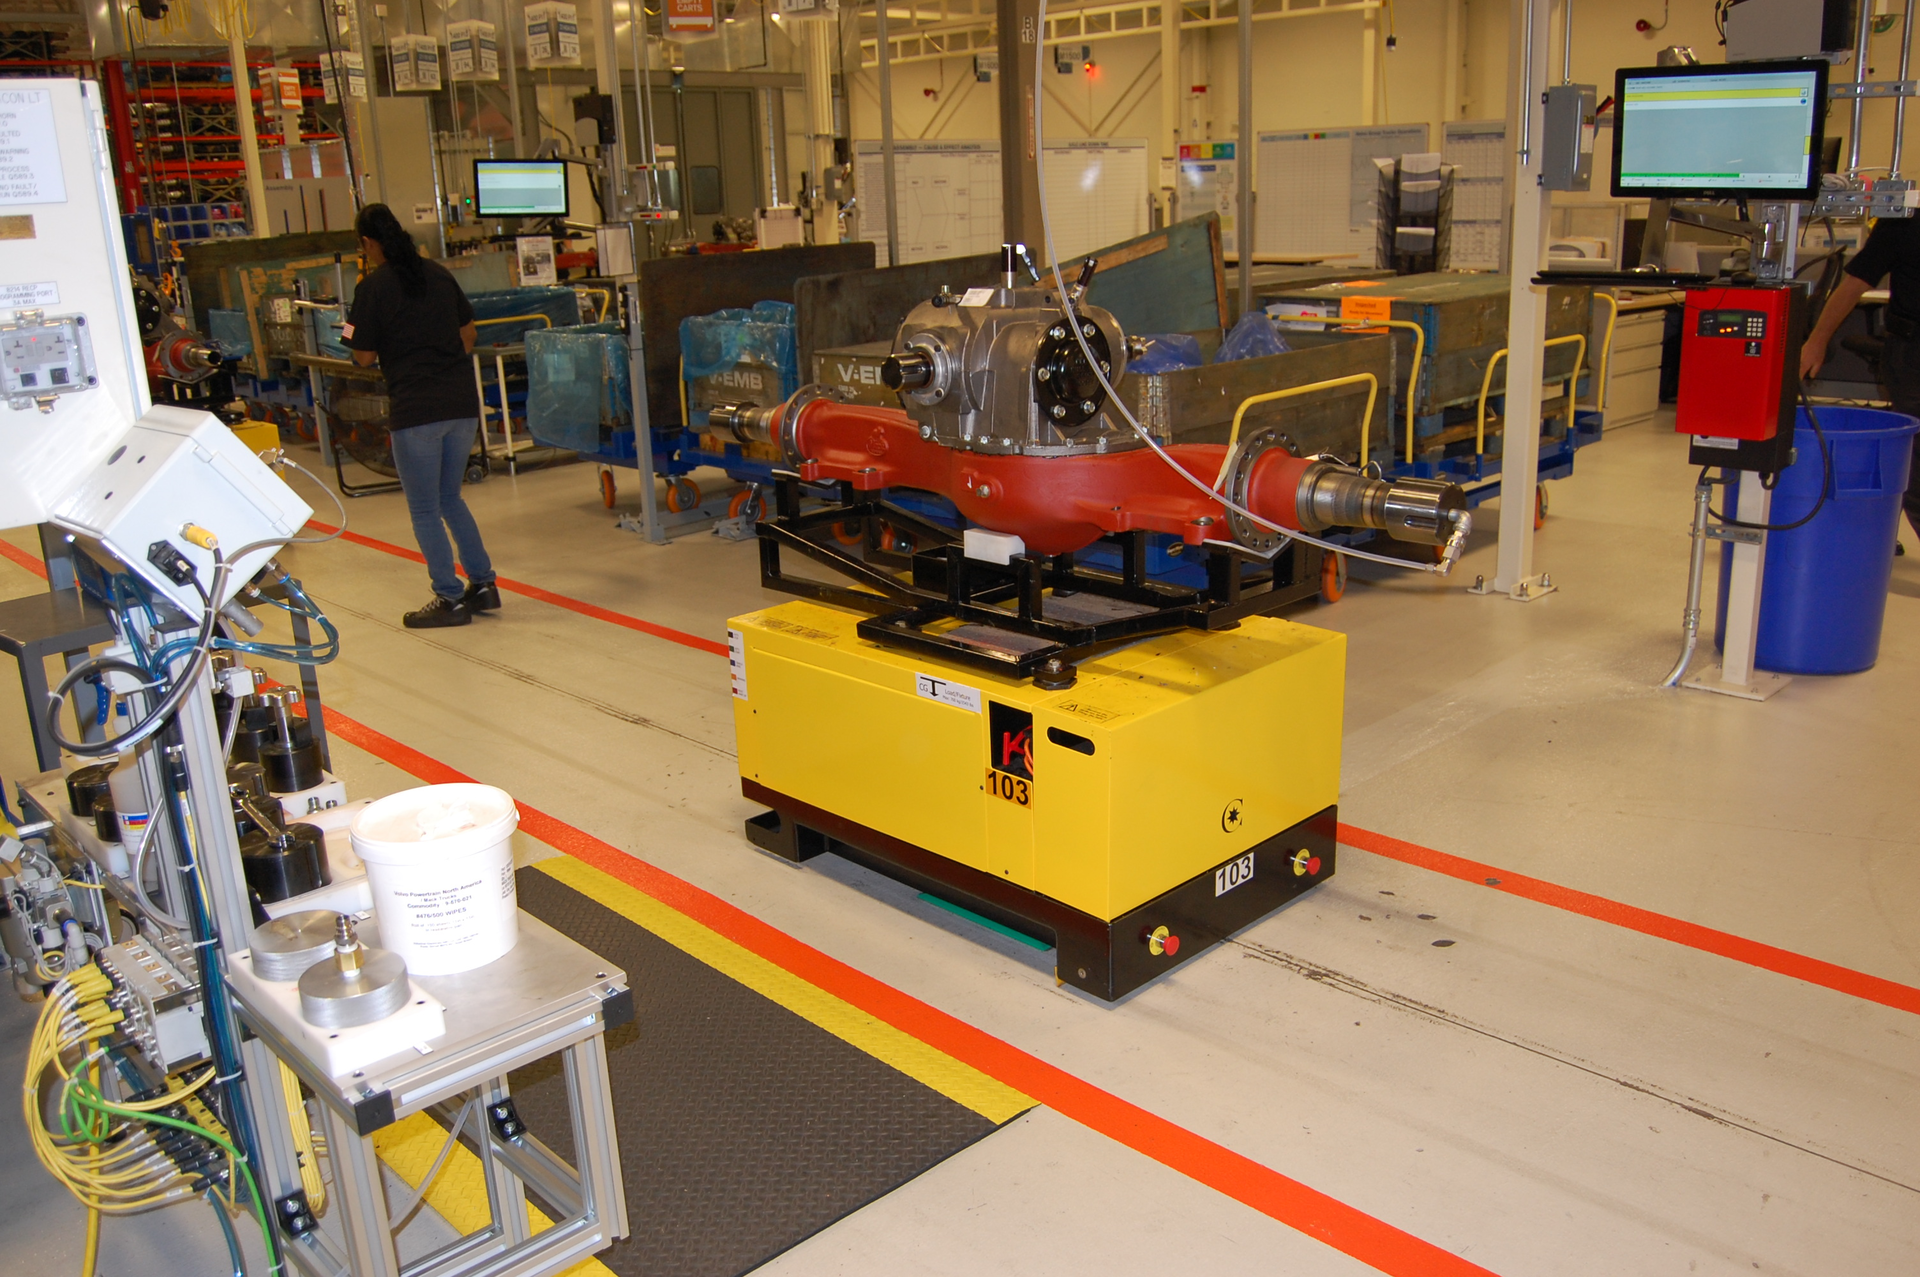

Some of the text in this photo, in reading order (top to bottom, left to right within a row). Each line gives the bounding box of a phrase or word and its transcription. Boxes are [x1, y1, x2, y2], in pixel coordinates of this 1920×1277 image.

[677, 4, 703, 12] CARTS
[28, 92, 41, 103] LT
[988, 770, 1029, 806] 103
[1219, 856, 1251, 891] 103
[460, 880, 482, 891] America
[445, 907, 467, 916] WIPES
